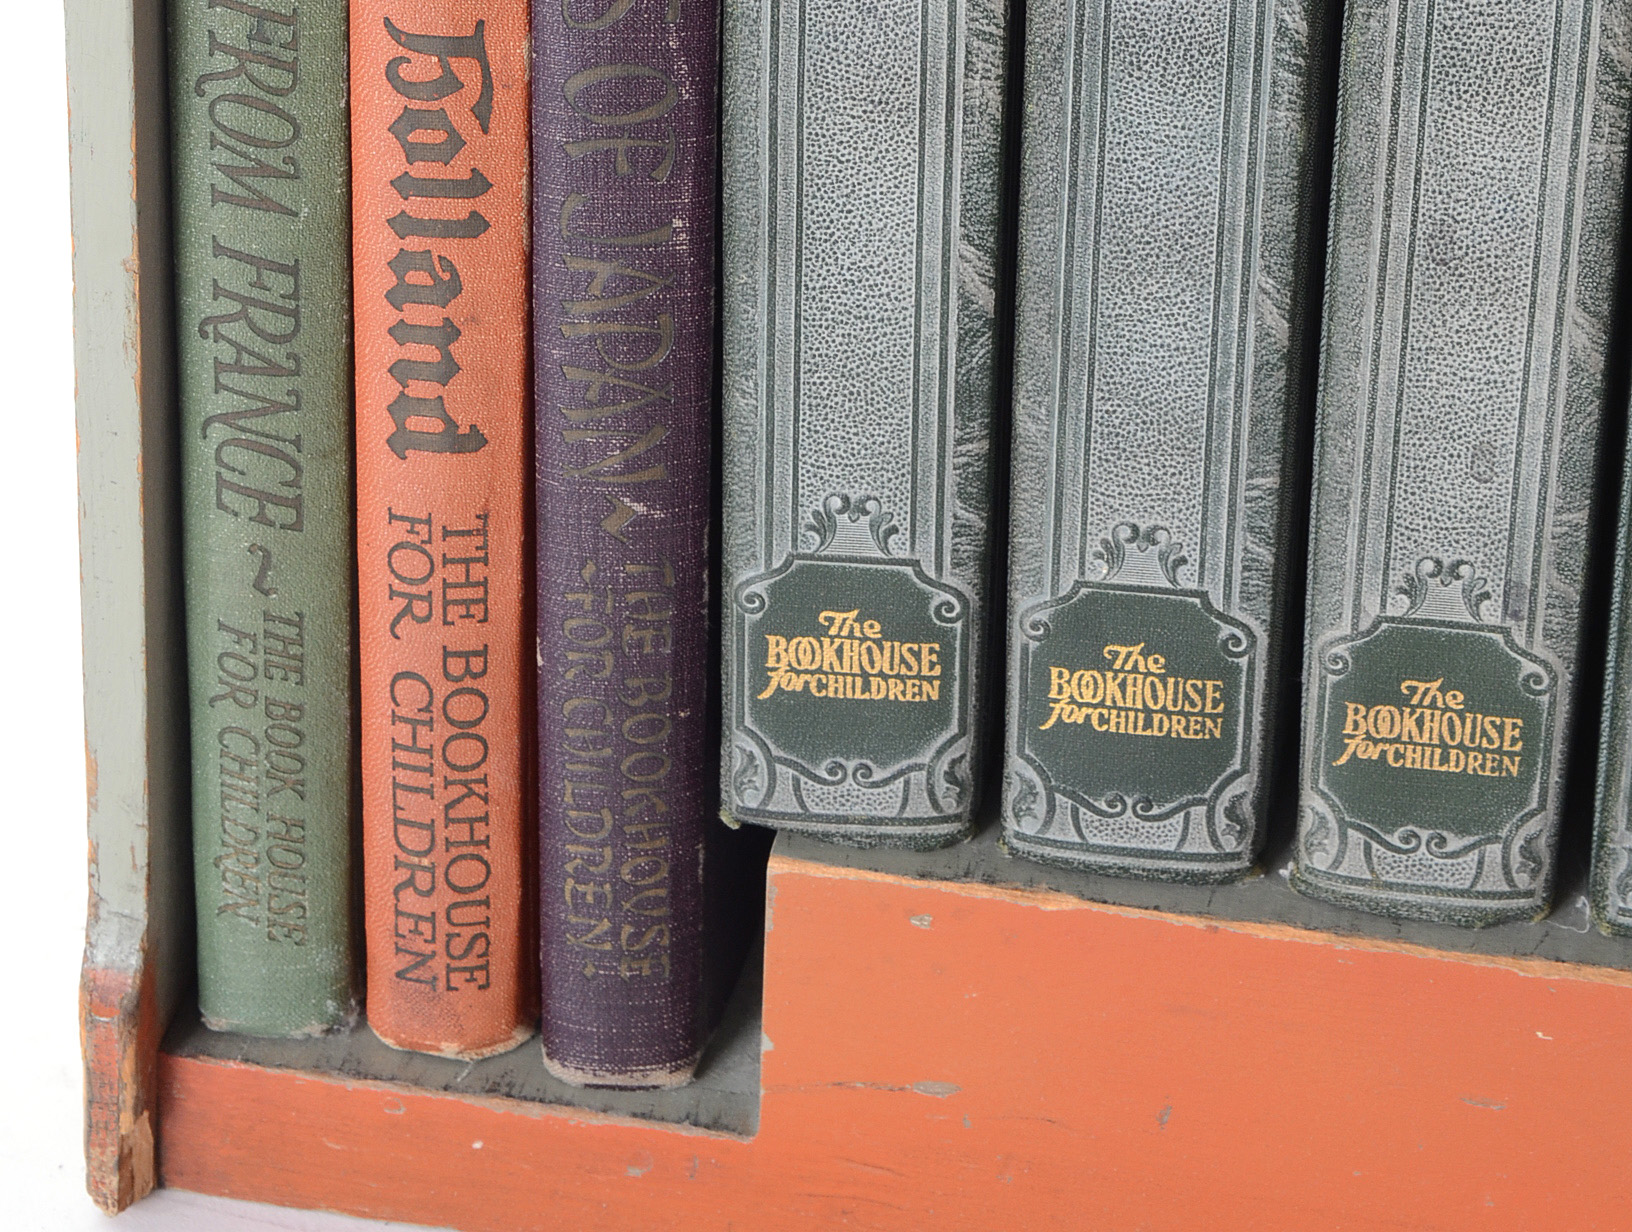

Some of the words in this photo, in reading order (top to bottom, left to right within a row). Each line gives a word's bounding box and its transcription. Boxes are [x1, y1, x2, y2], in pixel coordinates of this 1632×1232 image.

[562, 65, 678, 183] OF
[383, 16, 494, 460] Holland
[198, 234, 304, 533] FRANCE
[559, 192, 676, 484] JAPAN
[386, 506, 436, 640] FOR
[441, 513, 489, 626] THE
[621, 555, 677, 656] THE
[818, 609, 882, 638] The
[208, 618, 259, 709] FOR
[262, 610, 305, 685] THE
[562, 586, 614, 680] FOR
[765, 635, 941, 675] BOOKHOUSE
[1048, 666, 1224, 712] BOOKHOUSE
[1104, 642, 1165, 672] The
[264, 696, 306, 801] BOOK
[1342, 702, 1522, 750] BOOKHOUSE
[1401, 678, 1464, 709] The
[212, 725, 261, 926] CHILDREN
[389, 670, 438, 991] CHILDREN
[441, 643, 492, 992] BOOKHOUSE
[561, 696, 615, 951] CHILDREN
[618, 674, 673, 984] BOOKHOUSE
[265, 812, 308, 947] HOUSE
